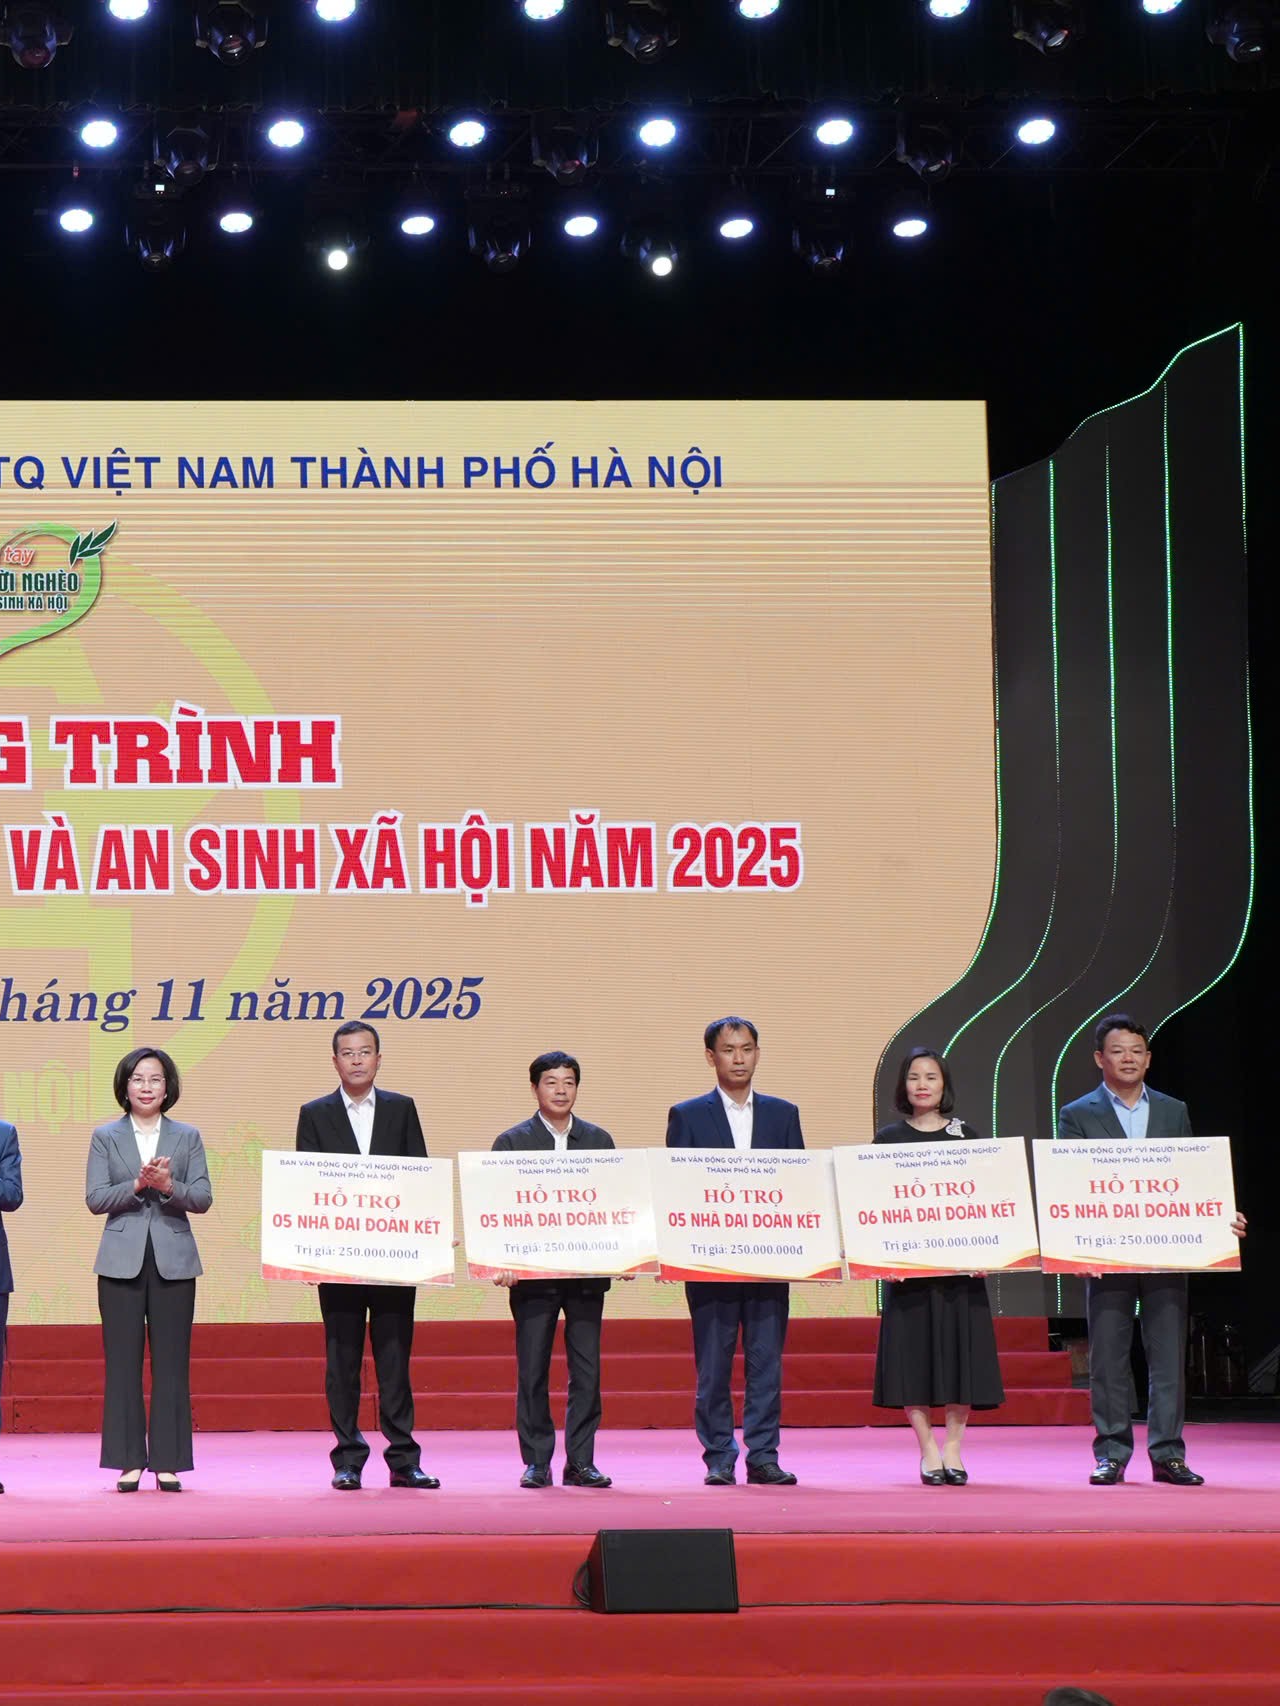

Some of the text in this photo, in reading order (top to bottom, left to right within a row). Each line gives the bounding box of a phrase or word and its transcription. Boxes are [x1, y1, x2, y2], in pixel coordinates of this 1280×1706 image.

[60, 447, 161, 496] VIỆT
[178, 456, 274, 488] NAM
[291, 447, 444, 488] THÀNH
[464, 441, 556, 489] PHỐ
[572, 447, 632, 488] HÀ
[649, 447, 721, 495] NỘI
[5, 546, 34, 564] tay
[23, 569, 78, 592] NGHÈO
[28, 594, 43, 609] XÃ
[48, 594, 68, 613] HỘI
[54, 706, 336, 784] TRÌNH
[10, 815, 82, 891] VÀ
[95, 829, 168, 890] AN
[188, 827, 315, 891] SINH
[333, 815, 407, 890] XÃ
[424, 816, 510, 903] HỘI
[530, 814, 650, 889] NĂM
[671, 826, 800, 888] 2025
[151, 978, 206, 1021] 11
[225, 977, 345, 1023] năm
[361, 976, 484, 1020] 2025
[516, 1184, 597, 1205] HỖ TRỢ
[704, 1183, 783, 1207] HỖ TRỢ
[894, 1177, 976, 1199] HỖ TRỢ
[1089, 1173, 1180, 1196] HỖ TRỢ
[314, 1187, 401, 1212] HỖ TRỢ
[1049, 1204, 1070, 1219] 05
[1075, 1200, 1108, 1218] NHÀ
[1195, 1197, 1223, 1217] KẾT
[273, 1213, 292, 1228] 05
[297, 1212, 329, 1230] NHÀ
[414, 1216, 440, 1235] KẾT
[668, 1212, 686, 1226] 05
[691, 1210, 720, 1227] NHÀ
[797, 1209, 821, 1229] KẾT
[858, 1210, 878, 1225] 06
[882, 1206, 913, 1224] NHÀ
[992, 1199, 1016, 1218] KẾT
[690, 1244, 803, 1256] Trị giá: 250.000.000đ
[883, 1235, 1000, 1253] Trị giá: 300.000.000đ
[1075, 1234, 1203, 1248] Trị giá: 250.000.000đ
